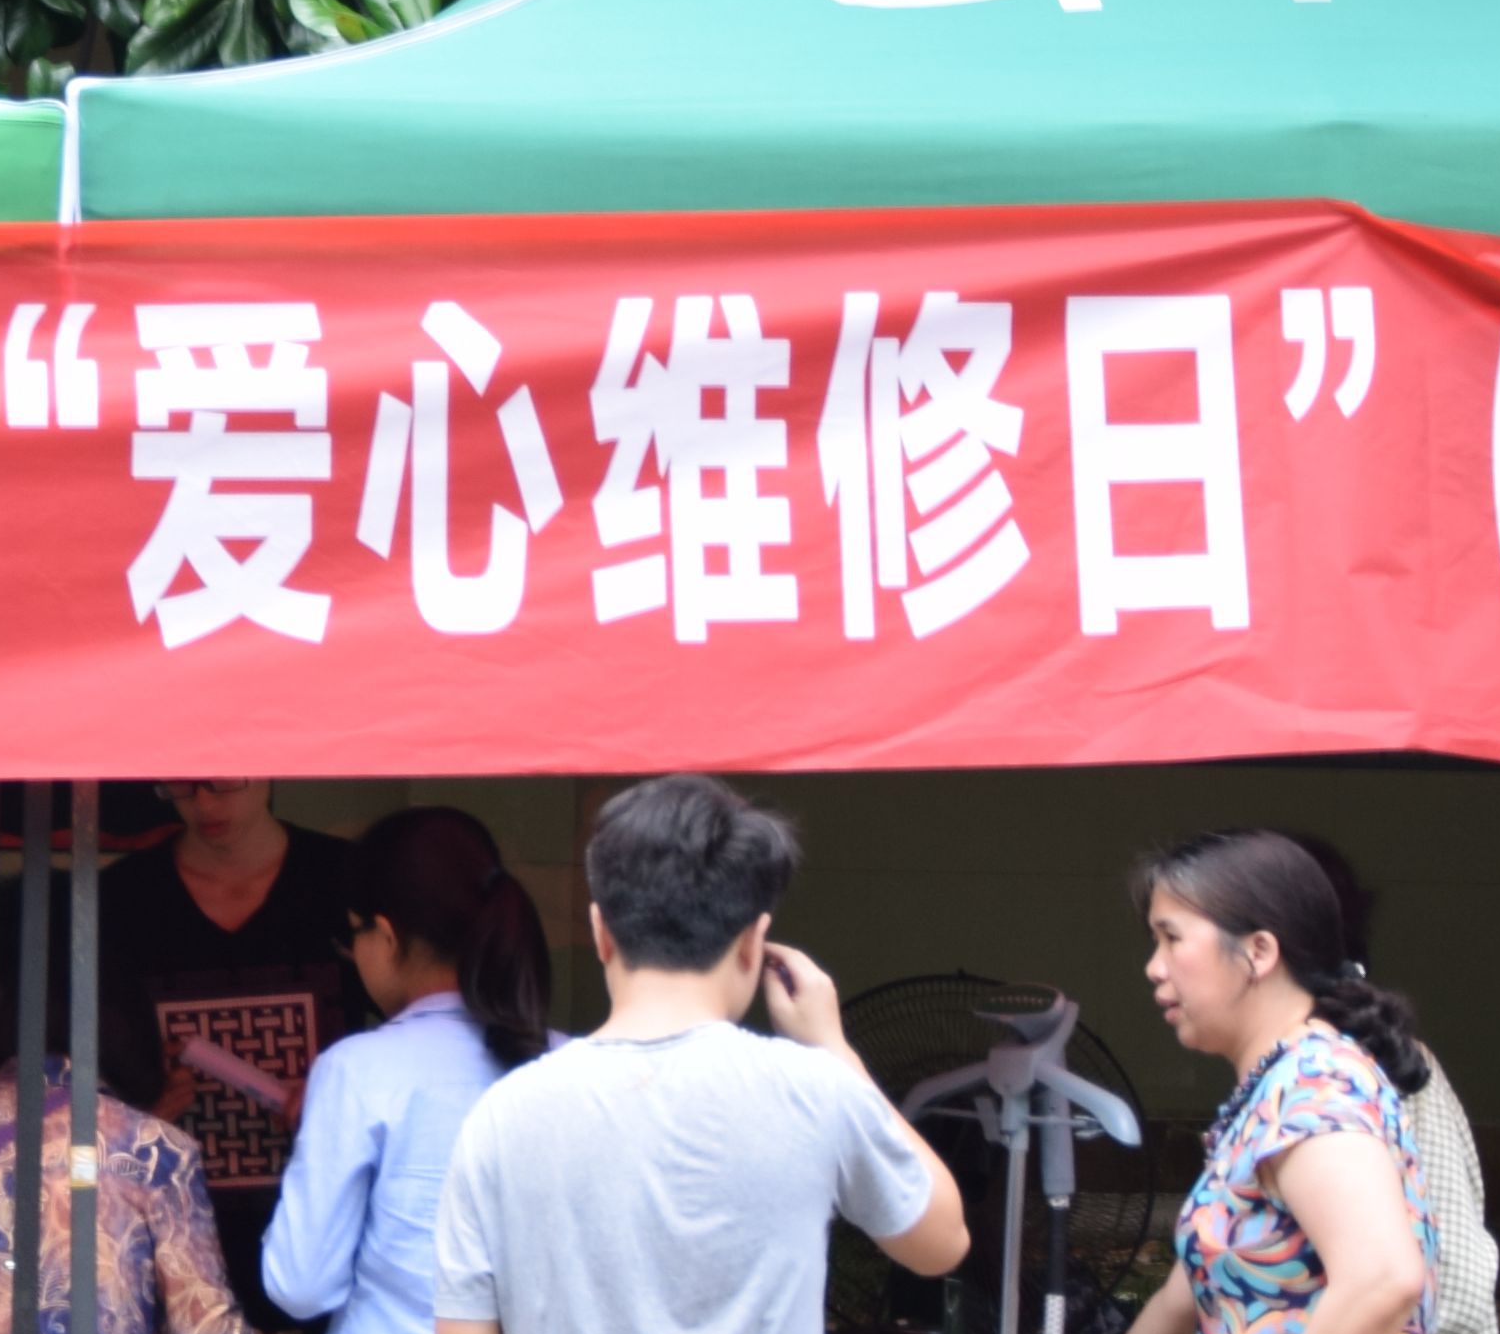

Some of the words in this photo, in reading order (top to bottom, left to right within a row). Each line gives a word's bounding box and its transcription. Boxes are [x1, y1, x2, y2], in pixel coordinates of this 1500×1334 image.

[2, 285, 1376, 651] “爱心维修日”
